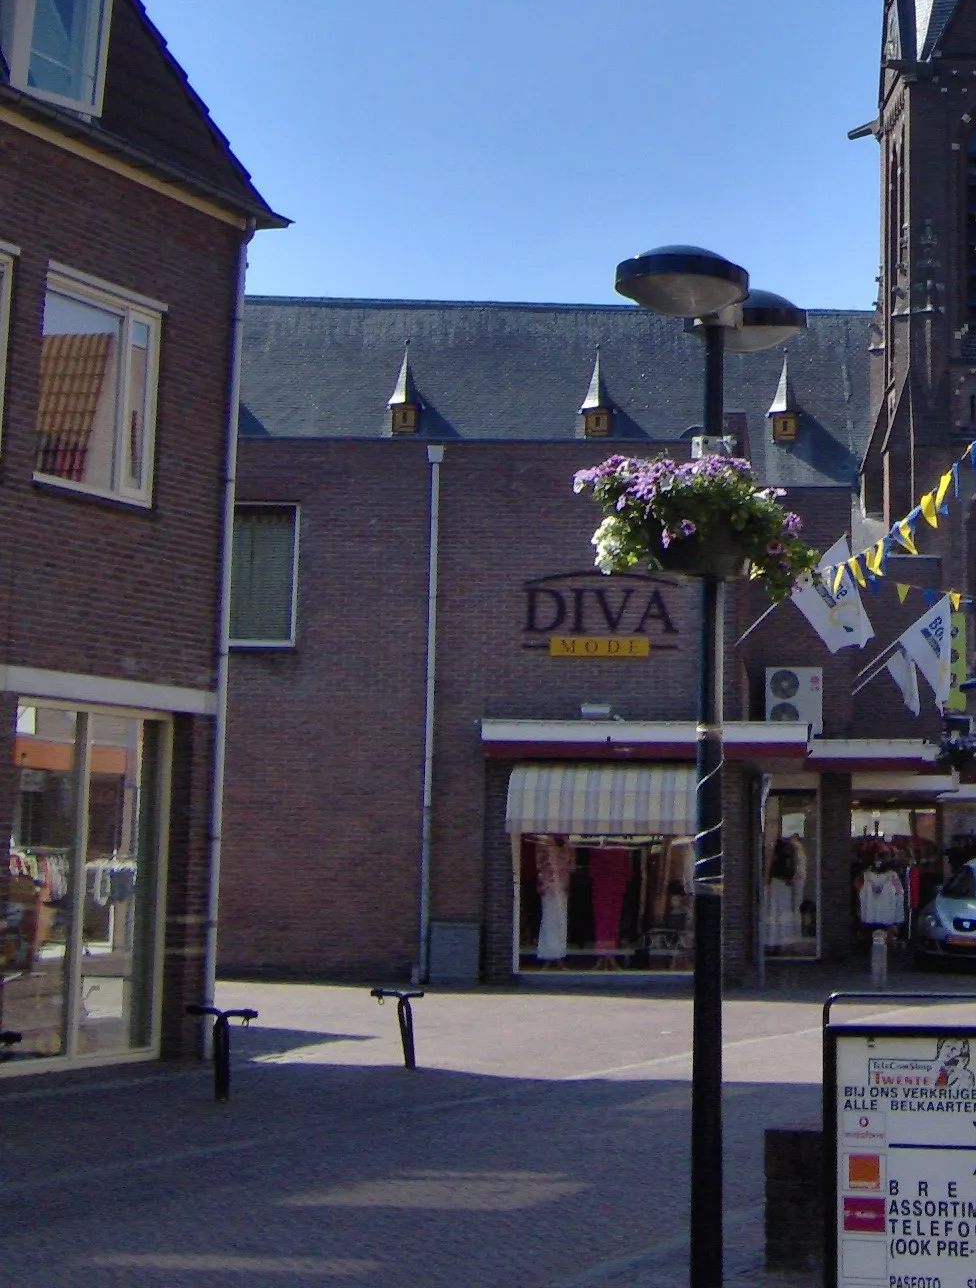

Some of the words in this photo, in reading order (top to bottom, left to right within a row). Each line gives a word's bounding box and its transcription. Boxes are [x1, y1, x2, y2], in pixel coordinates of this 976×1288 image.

[521, 588, 680, 633] DIVA
[560, 639, 639, 654] MODE
[844, 1086, 865, 1098] BIJ
[870, 1087, 898, 1099] ONS
[844, 1099, 878, 1111] ALLE
[889, 1238, 931, 1259] (OOK
